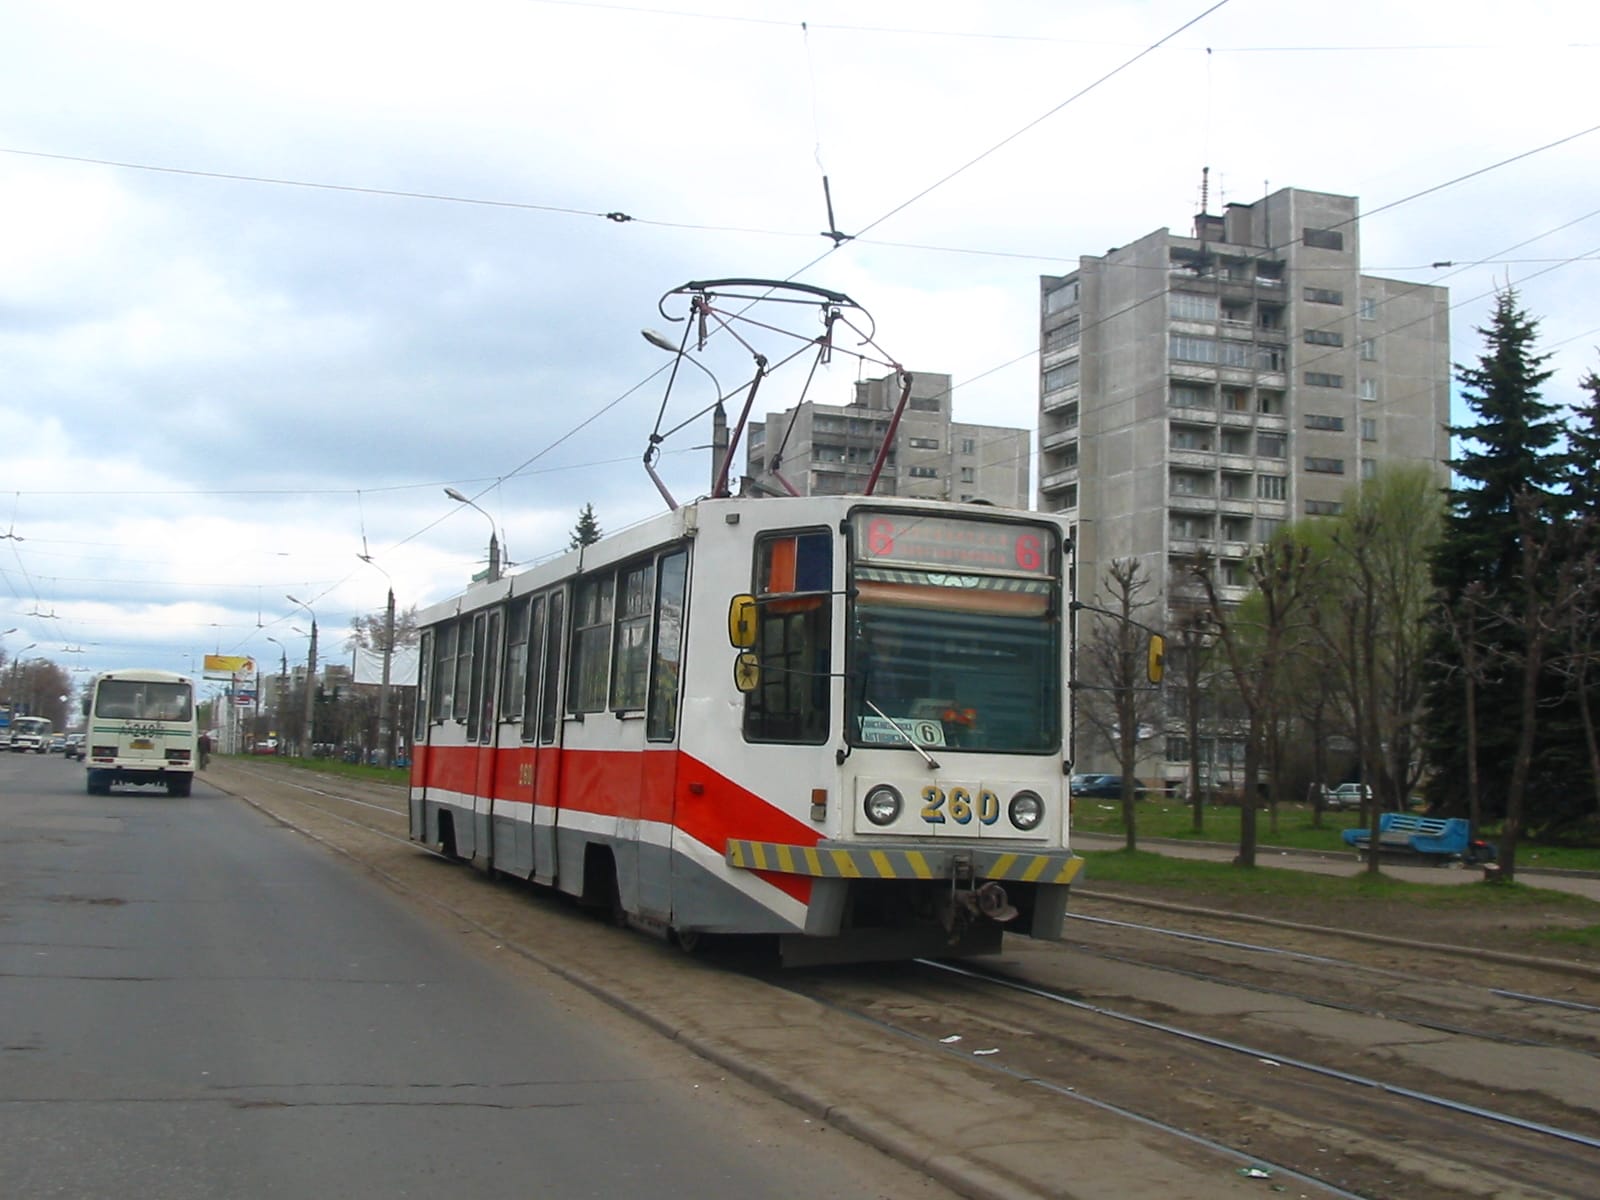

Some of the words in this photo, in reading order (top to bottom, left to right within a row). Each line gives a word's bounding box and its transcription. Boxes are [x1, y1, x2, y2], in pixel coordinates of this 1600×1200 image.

[868, 518, 895, 555] 6
[1015, 534, 1041, 570] 6
[921, 725, 935, 743] 6
[920, 785, 1000, 825] 260
